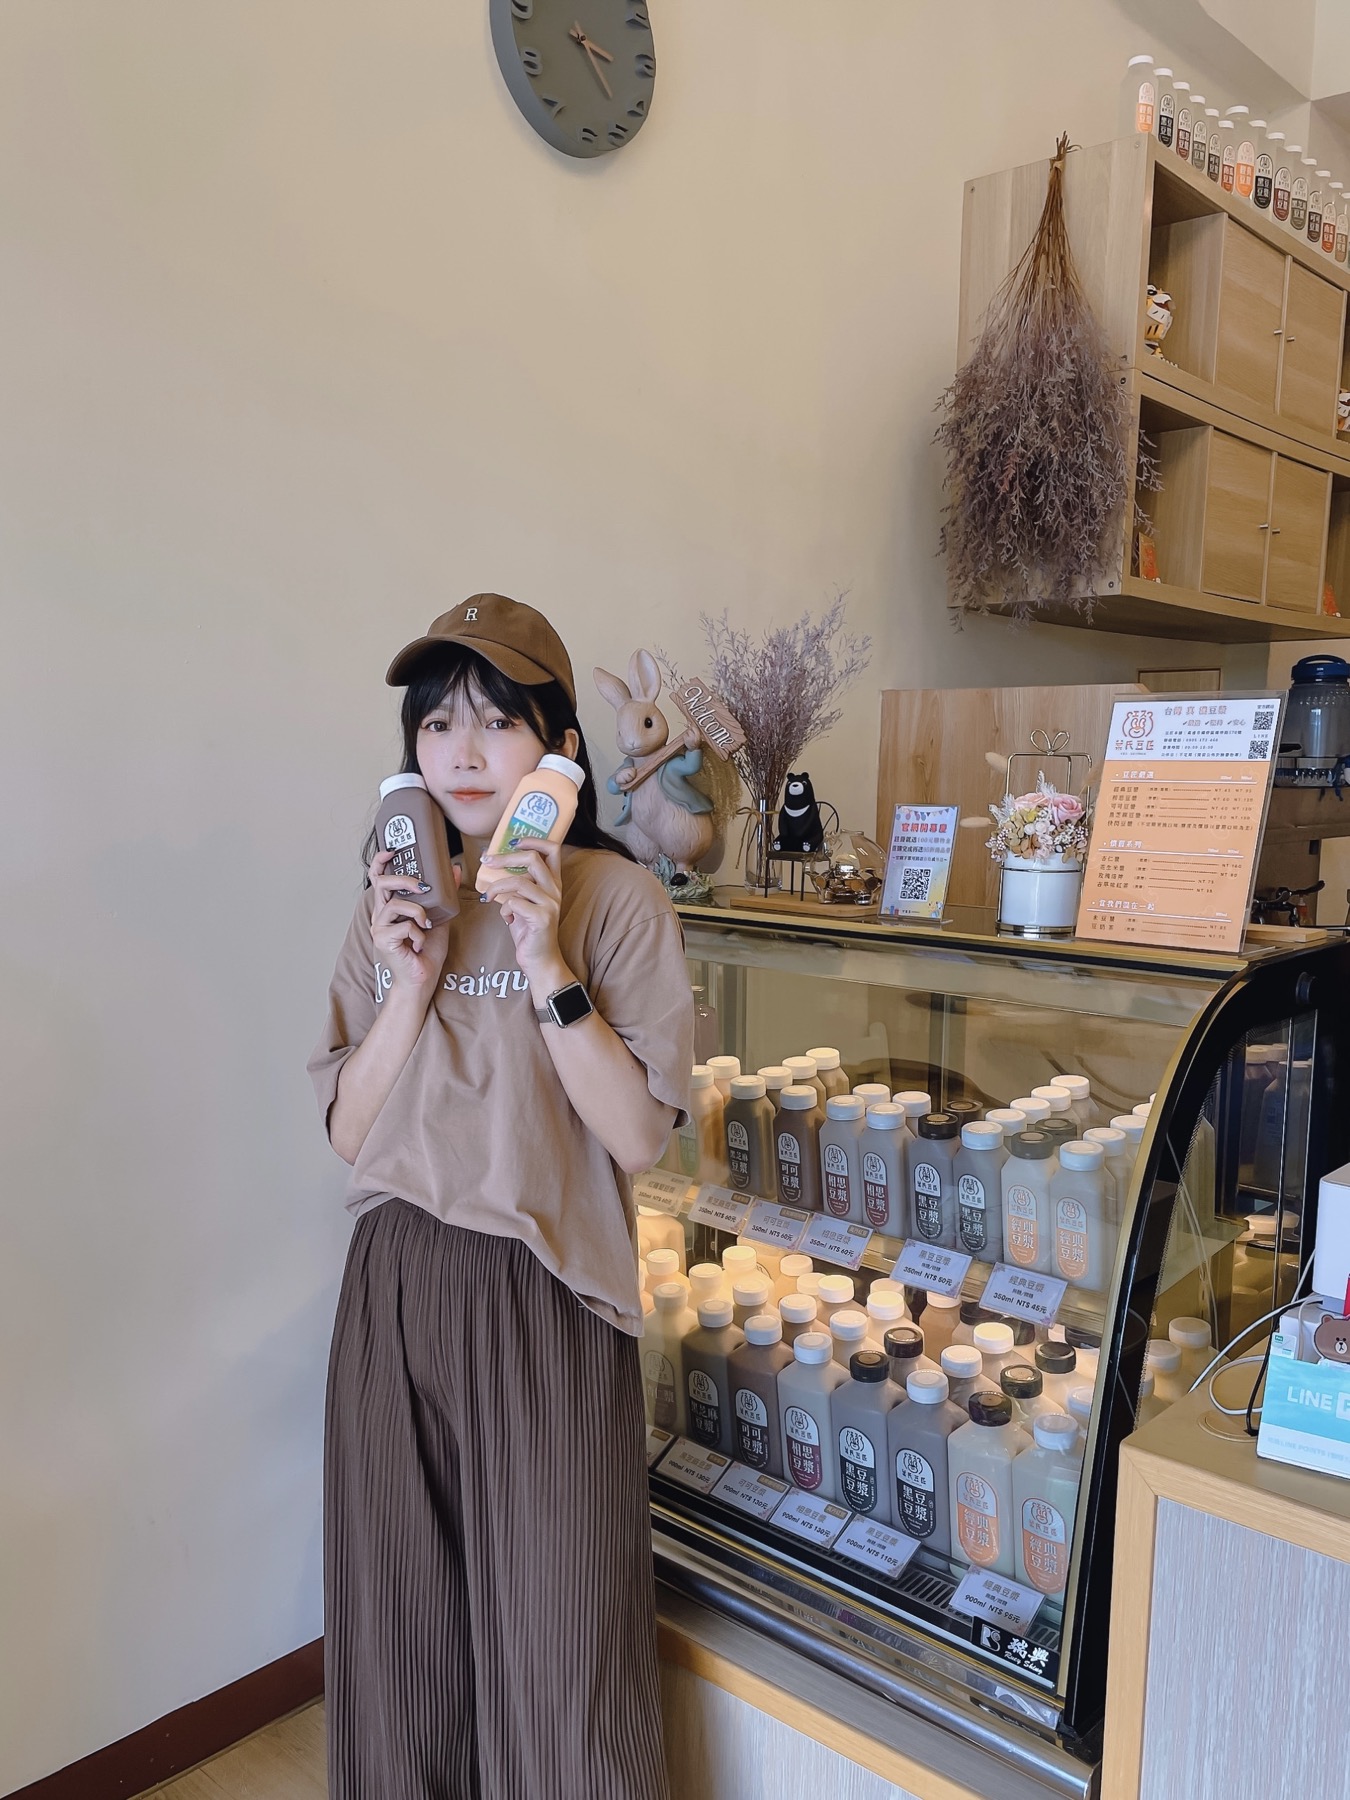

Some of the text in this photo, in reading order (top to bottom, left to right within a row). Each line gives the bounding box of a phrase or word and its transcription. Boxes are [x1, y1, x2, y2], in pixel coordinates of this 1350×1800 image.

[464, 608, 478, 621] R
[684, 686, 734, 750] Welcome
[392, 847, 416, 866] 可可
[731, 1160, 748, 1174] 豆漿
[781, 1161, 798, 1177] 可可
[782, 1174, 800, 1189] 豆漿
[828, 1174, 846, 1189] 相思
[866, 1183, 885, 1199] 相思
[828, 1188, 847, 1202] 豆漿
[867, 1197, 886, 1212] 豆漿
[918, 1194, 938, 1210] 黑豆
[918, 1208, 939, 1224] 豆漿
[961, 1206, 983, 1223] 黑豆
[962, 1221, 984, 1237] 豆漿
[1011, 1217, 1034, 1235] 經典
[809, 1239, 826, 1247] 350ml
[840, 1248, 853, 1256] 60元
[1012, 1232, 1035, 1249] 豆漿
[1059, 1231, 1084, 1249] 經典
[918, 1250, 950, 1265] 黑豆豆漿
[1060, 1245, 1084, 1263] 豆漿
[903, 1267, 921, 1275] 350ml
[1008, 1275, 1044, 1291] 經典豆漿
[993, 1293, 1013, 1302] 350ml
[1031, 1304, 1046, 1312] 45元
[1287, 1386, 1333, 1411] LINE
[741, 1422, 761, 1441] 可可
[742, 1436, 764, 1455] 豆漿
[791, 1440, 814, 1459] 相思
[792, 1454, 815, 1475] 豆漿
[845, 1461, 868, 1481] 黑豆
[722, 1485, 738, 1494] 900ml
[752, 1498, 767, 1508] 130元
[846, 1479, 869, 1498] 豆漿
[902, 1484, 927, 1507] 黑豆
[903, 1501, 928, 1522] 豆漿
[964, 1508, 989, 1530] 經典
[782, 1512, 799, 1522] 900ml
[813, 1526, 830, 1536] 130元
[966, 1526, 990, 1548] 豆漿
[845, 1538, 898, 1565] 900ml NT$ 110元
[1029, 1535, 1057, 1559] 經典
[1030, 1551, 1058, 1575] 豆漿
[982, 1580, 1020, 1600] 經典豆漿
[964, 1594, 1020, 1622] 900ml NT$ 95元
